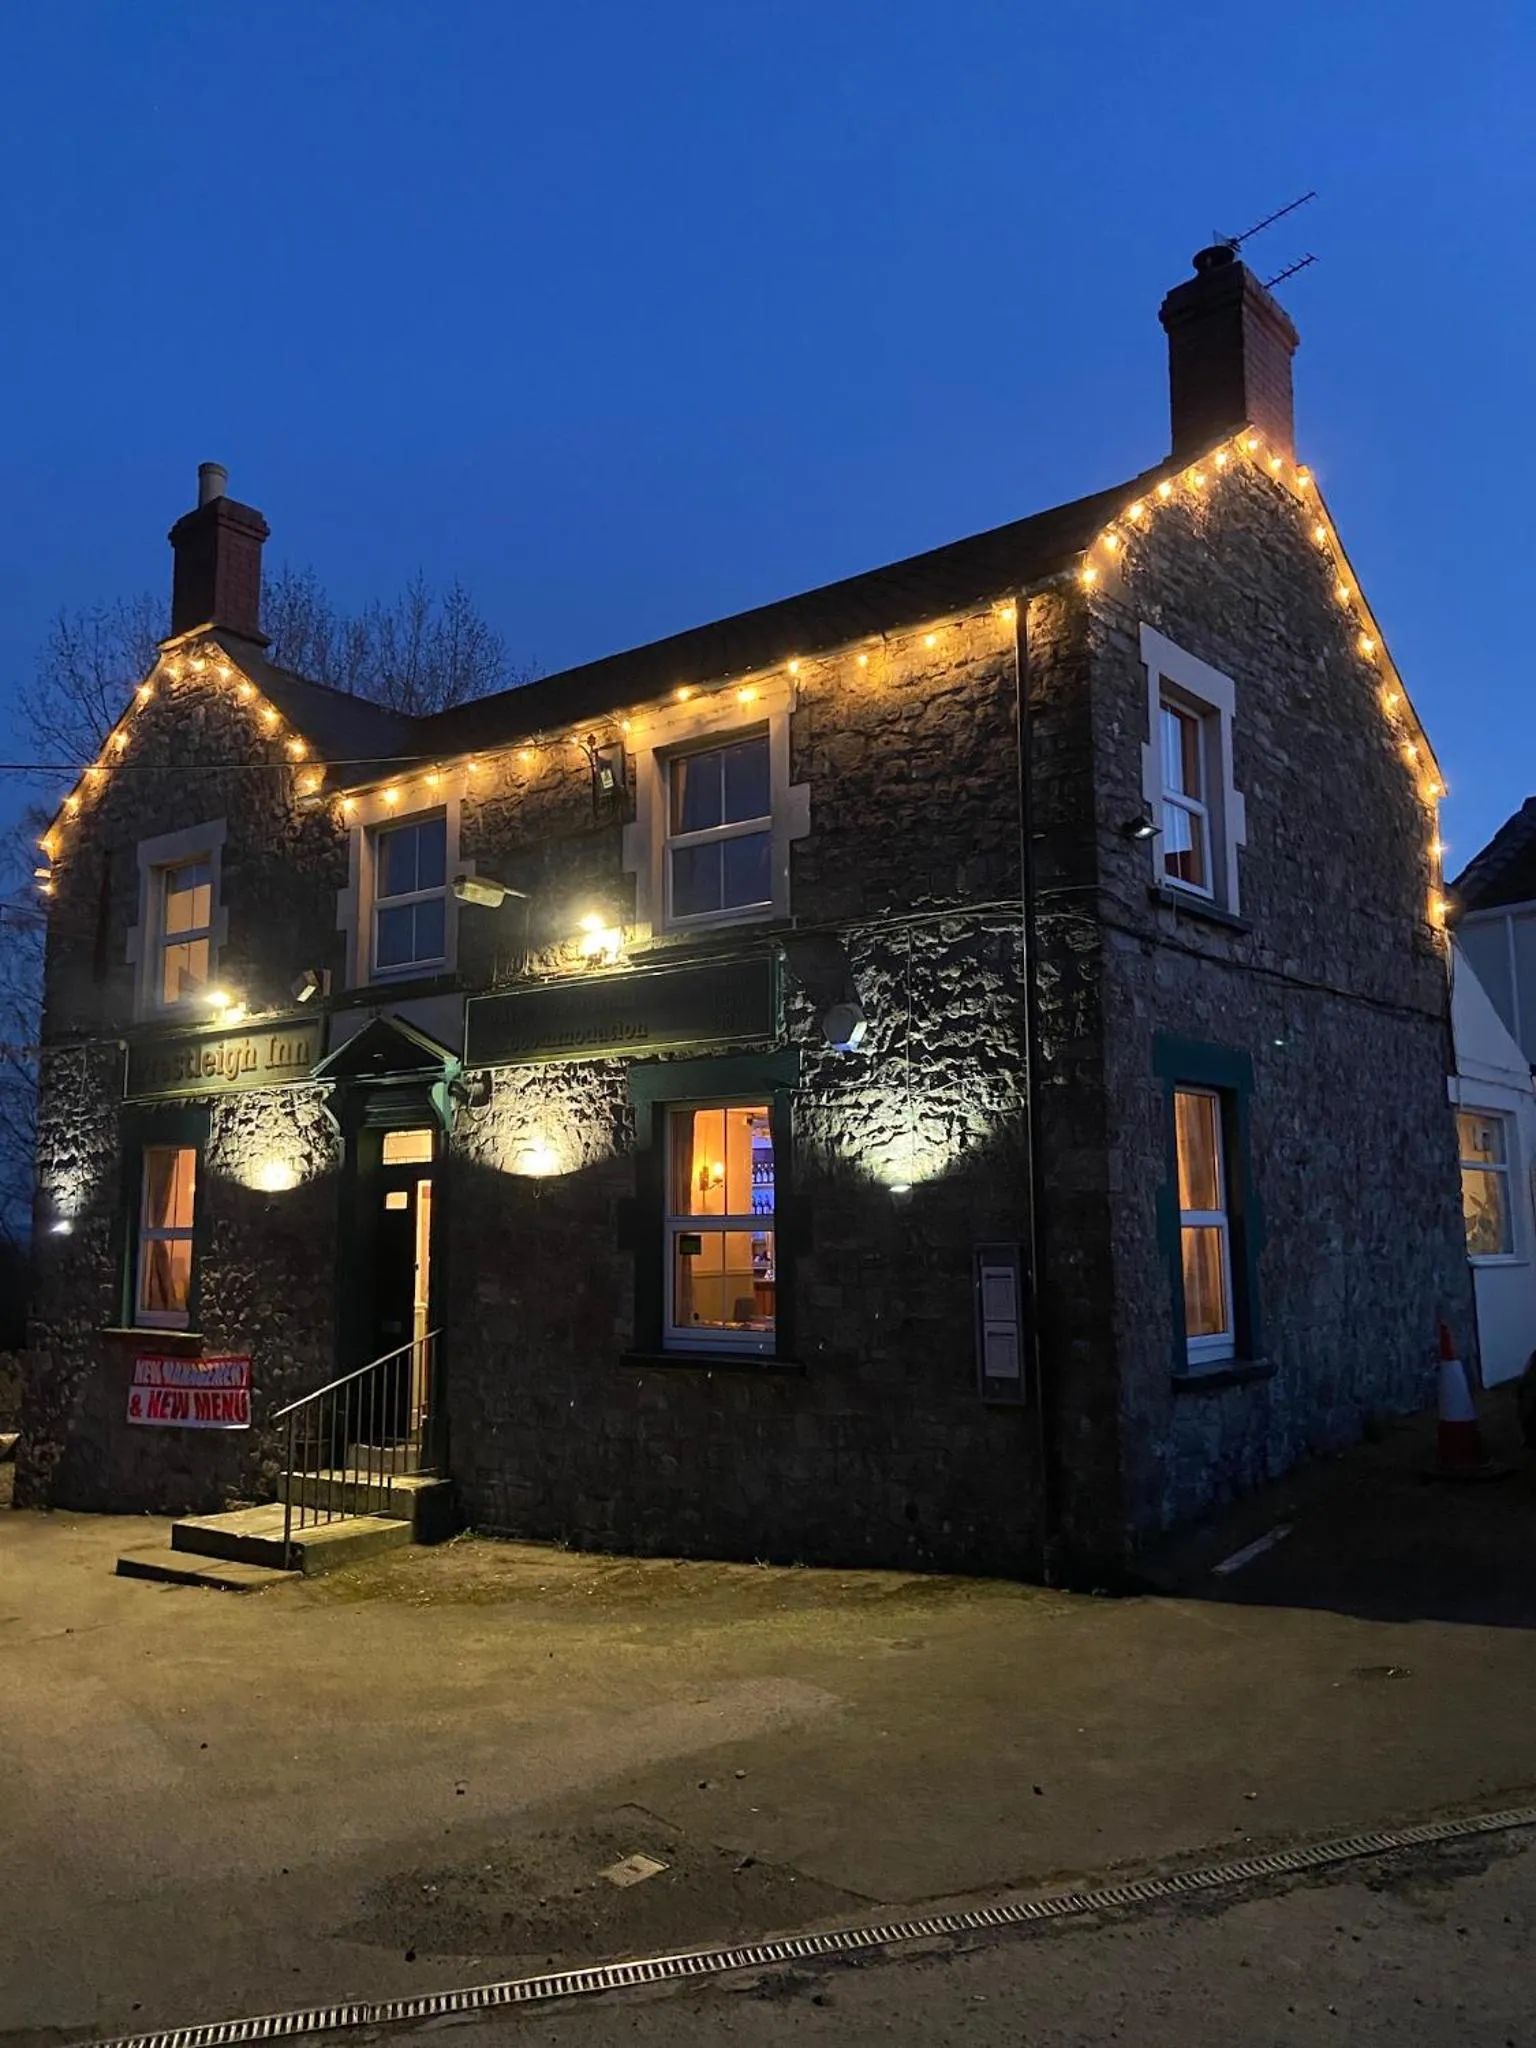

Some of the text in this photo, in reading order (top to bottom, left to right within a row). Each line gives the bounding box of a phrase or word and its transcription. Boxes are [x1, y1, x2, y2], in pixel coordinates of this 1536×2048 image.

[265, 1036, 310, 1069] Inn
[133, 1359, 163, 1384] NEW
[130, 1390, 249, 1422] & NEW MENU
